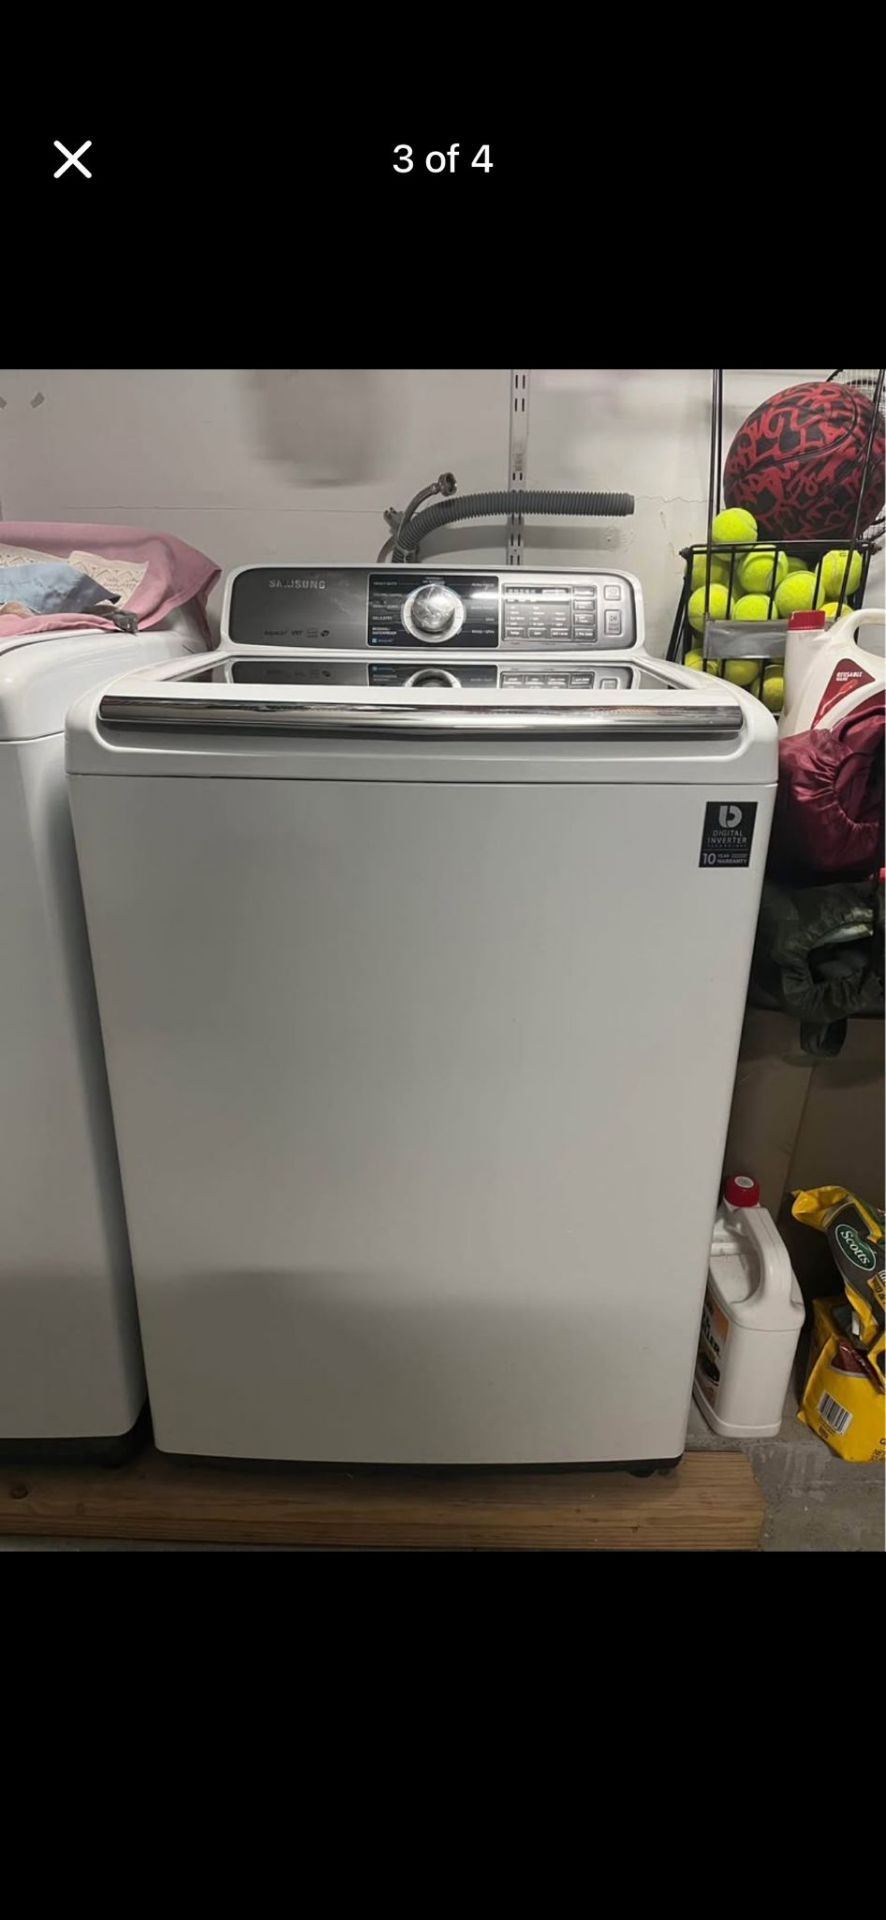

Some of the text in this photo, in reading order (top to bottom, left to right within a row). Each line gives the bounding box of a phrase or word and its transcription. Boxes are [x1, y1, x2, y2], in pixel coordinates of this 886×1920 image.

[712, 829, 743, 837] DIGITAL
[703, 853, 717, 865] 10
[839, 1230, 871, 1265] Scotts
